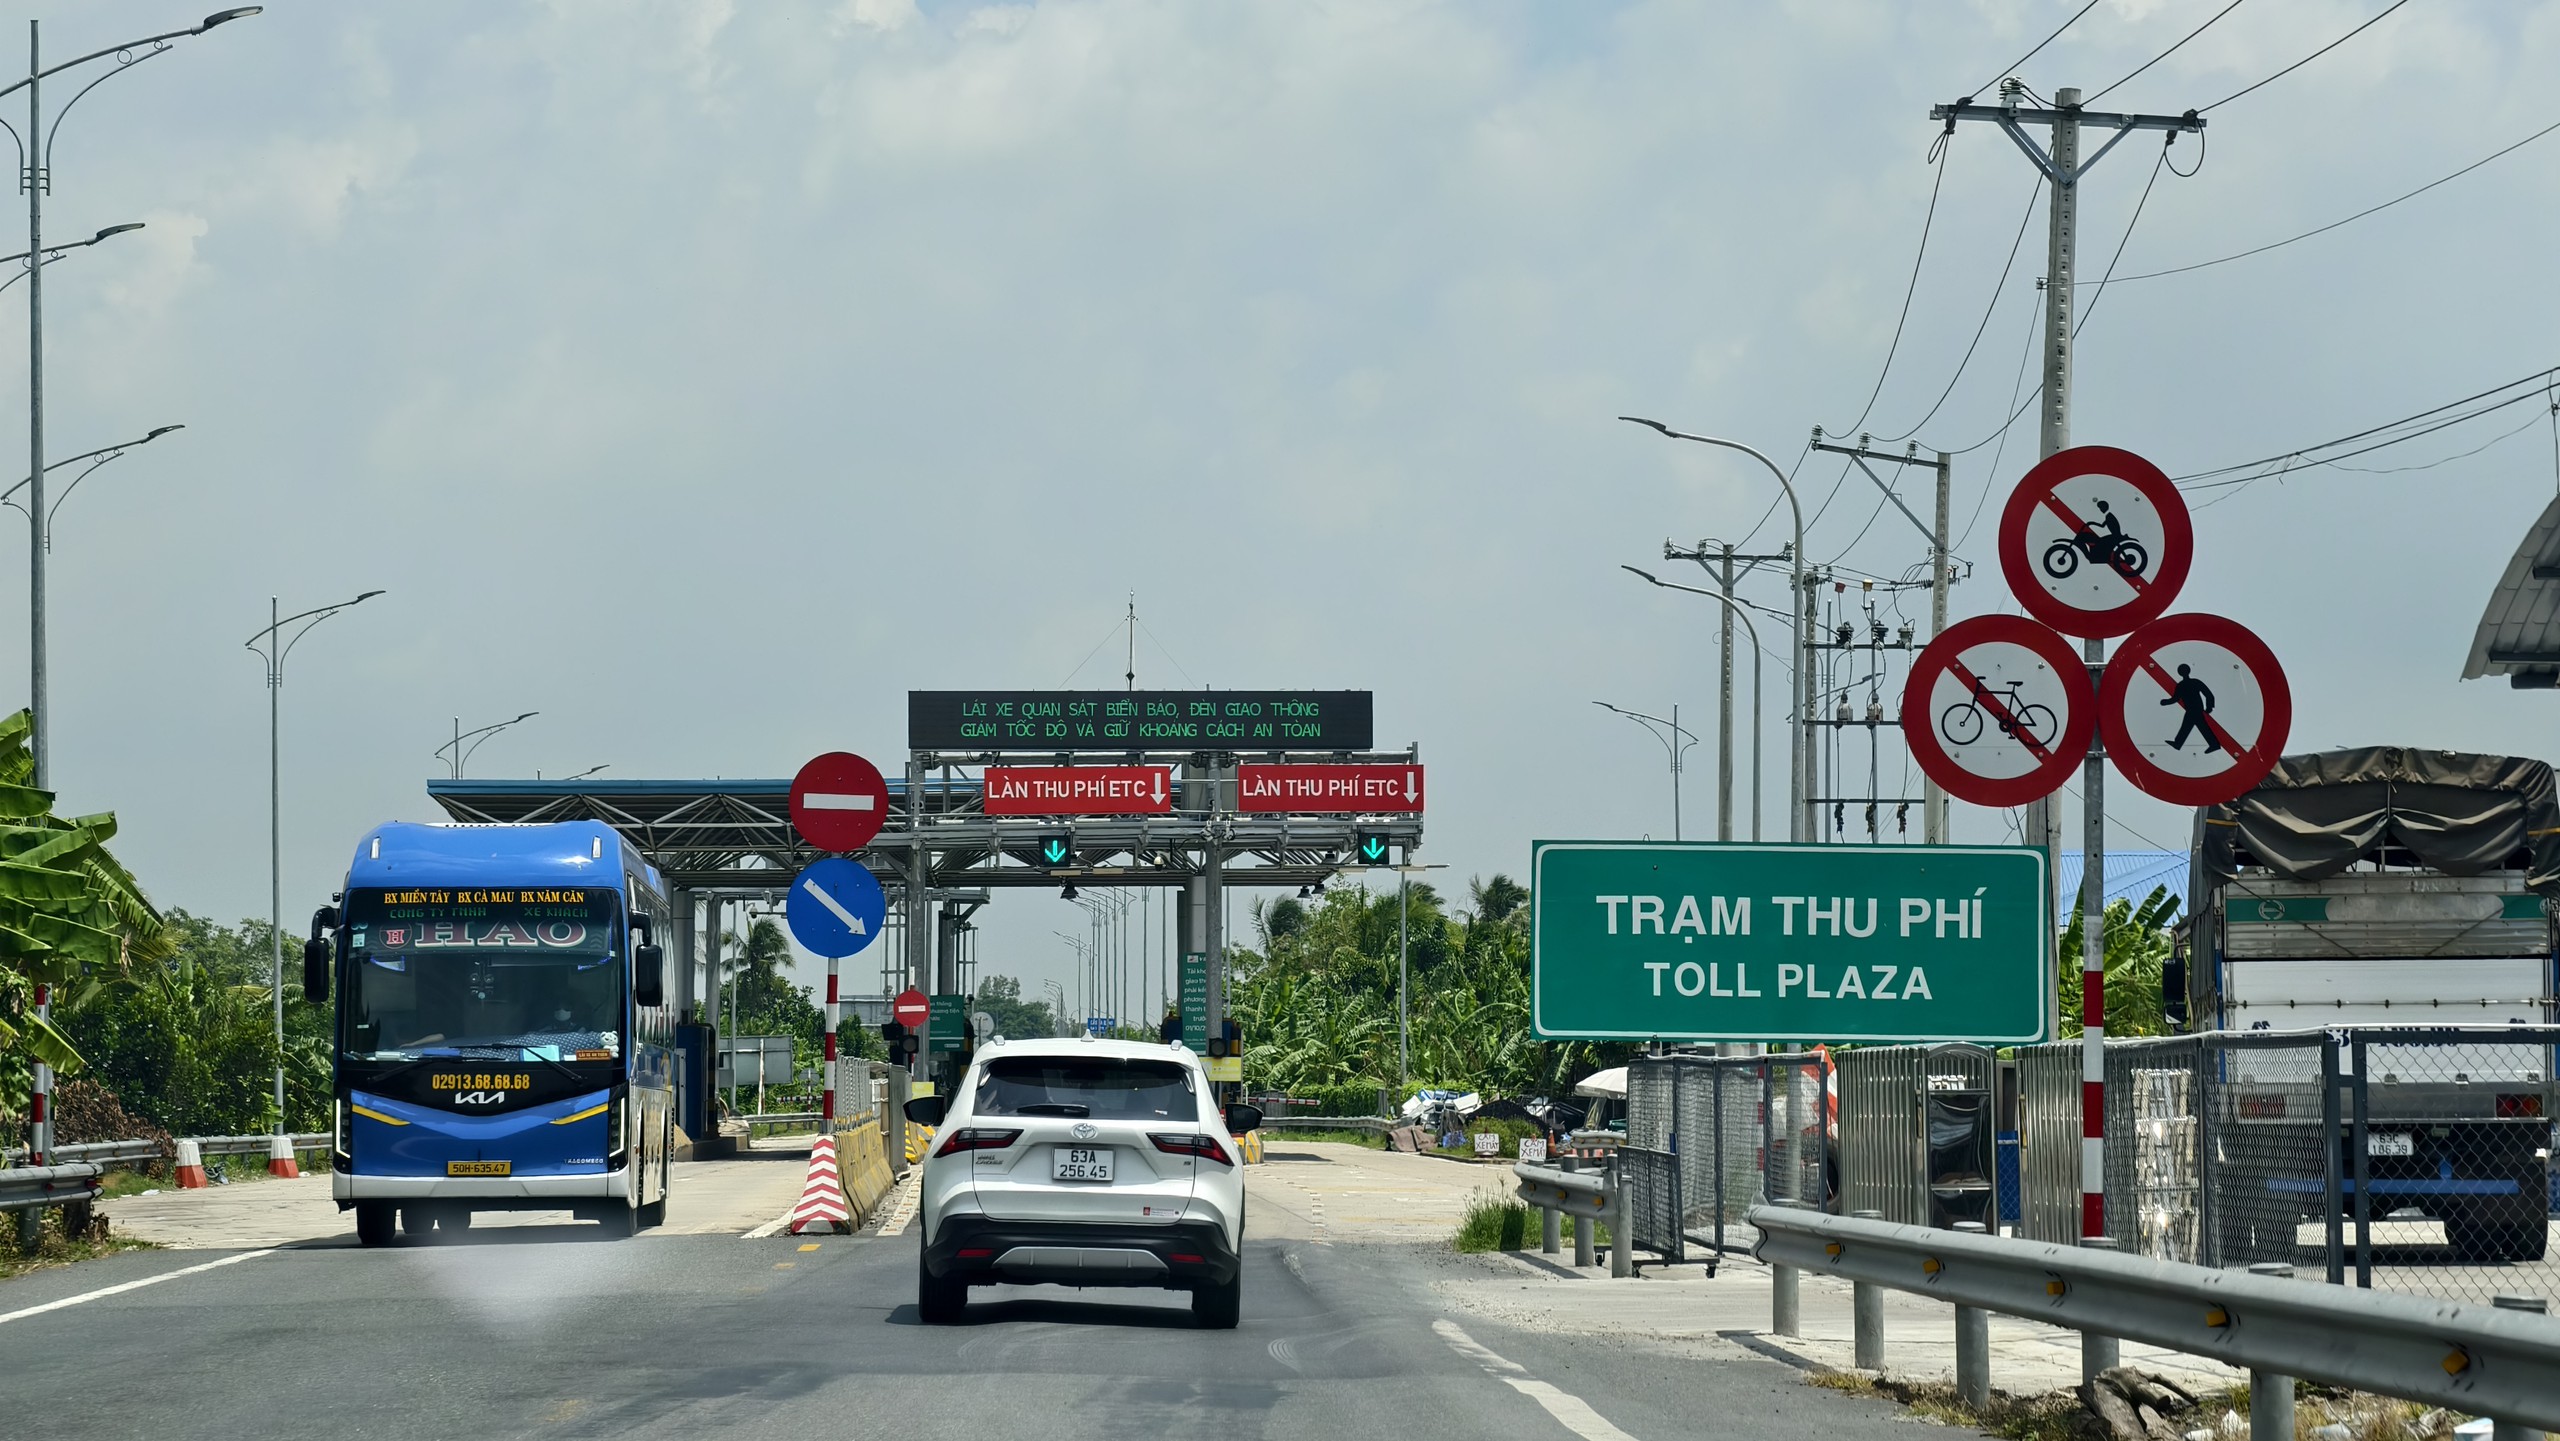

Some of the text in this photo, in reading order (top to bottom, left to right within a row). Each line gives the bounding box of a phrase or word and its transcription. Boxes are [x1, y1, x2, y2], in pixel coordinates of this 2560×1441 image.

[962, 698, 987, 717] LÁI
[995, 702, 1014, 717] XE
[1021, 702, 1061, 720] QUAN
[1068, 698, 1098, 717] SÁT
[1189, 698, 1217, 717] ĐÈN
[1224, 702, 1262, 717] GIAO
[1269, 698, 1320, 717] THÔNG
[1045, 719, 1068, 740] ĐỘ
[1205, 719, 1245, 738] CÁCH
[1252, 723, 1273, 738] AN
[988, 774, 1147, 799] LÀN THU PHÍ ETC
[1242, 774, 1399, 797] LÀN THU PHÍ ETC
[384, 892, 398, 904] BX
[457, 891, 471, 903] BX
[490, 891, 515, 903] MAU
[521, 891, 535, 903] BX
[1595, 886, 1988, 944] TRẠM THU PHÍ
[1643, 961, 1933, 1001] TOLL PLAZA
[432, 1074, 530, 1090] 02913.68.68.68
[1070, 1150, 1096, 1163] 63A
[453, 1163, 506, 1174] 50H-635.47
[1059, 1165, 1107, 1179] 256.45
